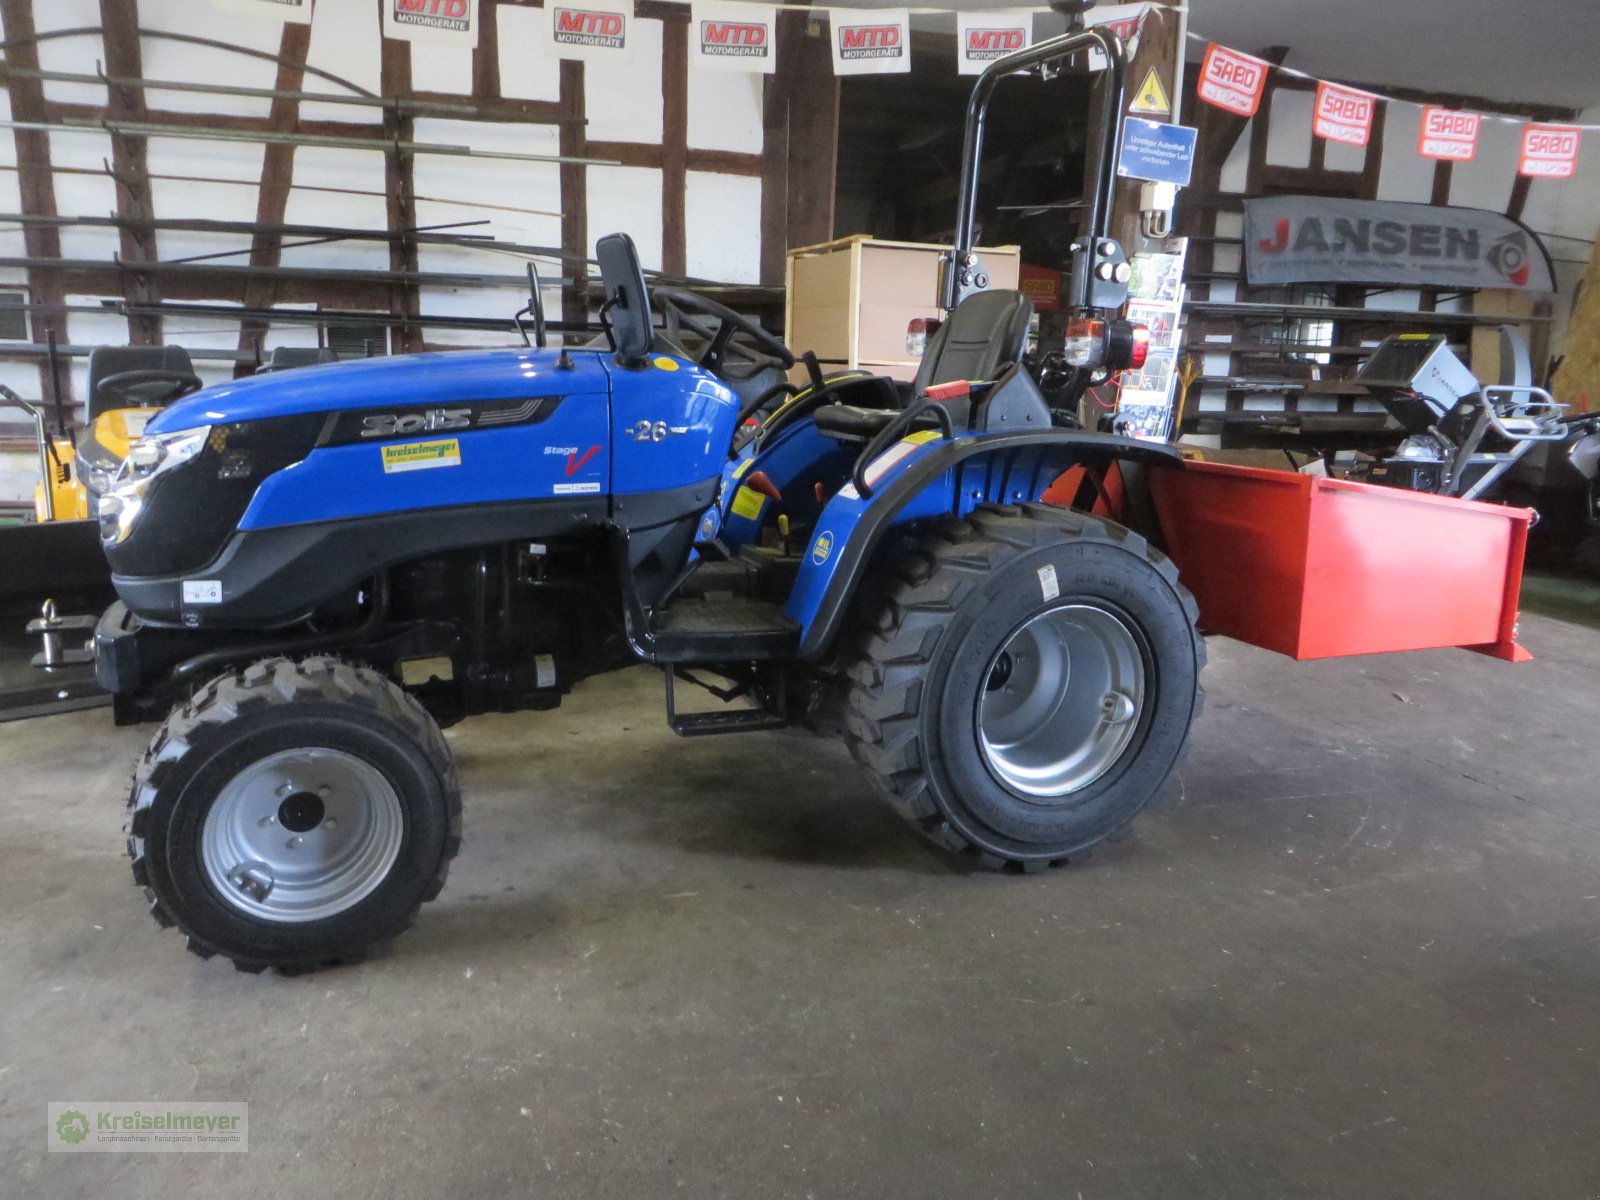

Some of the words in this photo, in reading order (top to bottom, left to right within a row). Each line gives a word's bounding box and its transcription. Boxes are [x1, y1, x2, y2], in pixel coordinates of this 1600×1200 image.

[558, 11, 621, 36] MTD
[557, 34, 621, 48] MOTORGERÄTE
[705, 24, 766, 45] MTD
[843, 27, 900, 48] MTD
[969, 31, 1023, 49] MTD
[705, 45, 764, 57] MOTORGERÄTE
[843, 46, 900, 59] MOTORGERÄTE
[1210, 57, 1255, 88] SABO
[1323, 95, 1368, 121] SABO
[1429, 115, 1475, 136] SABO
[1528, 134, 1574, 154] SABO
[1259, 217, 1480, 260] JANSEN
[543, 446, 579, 456] Stage
